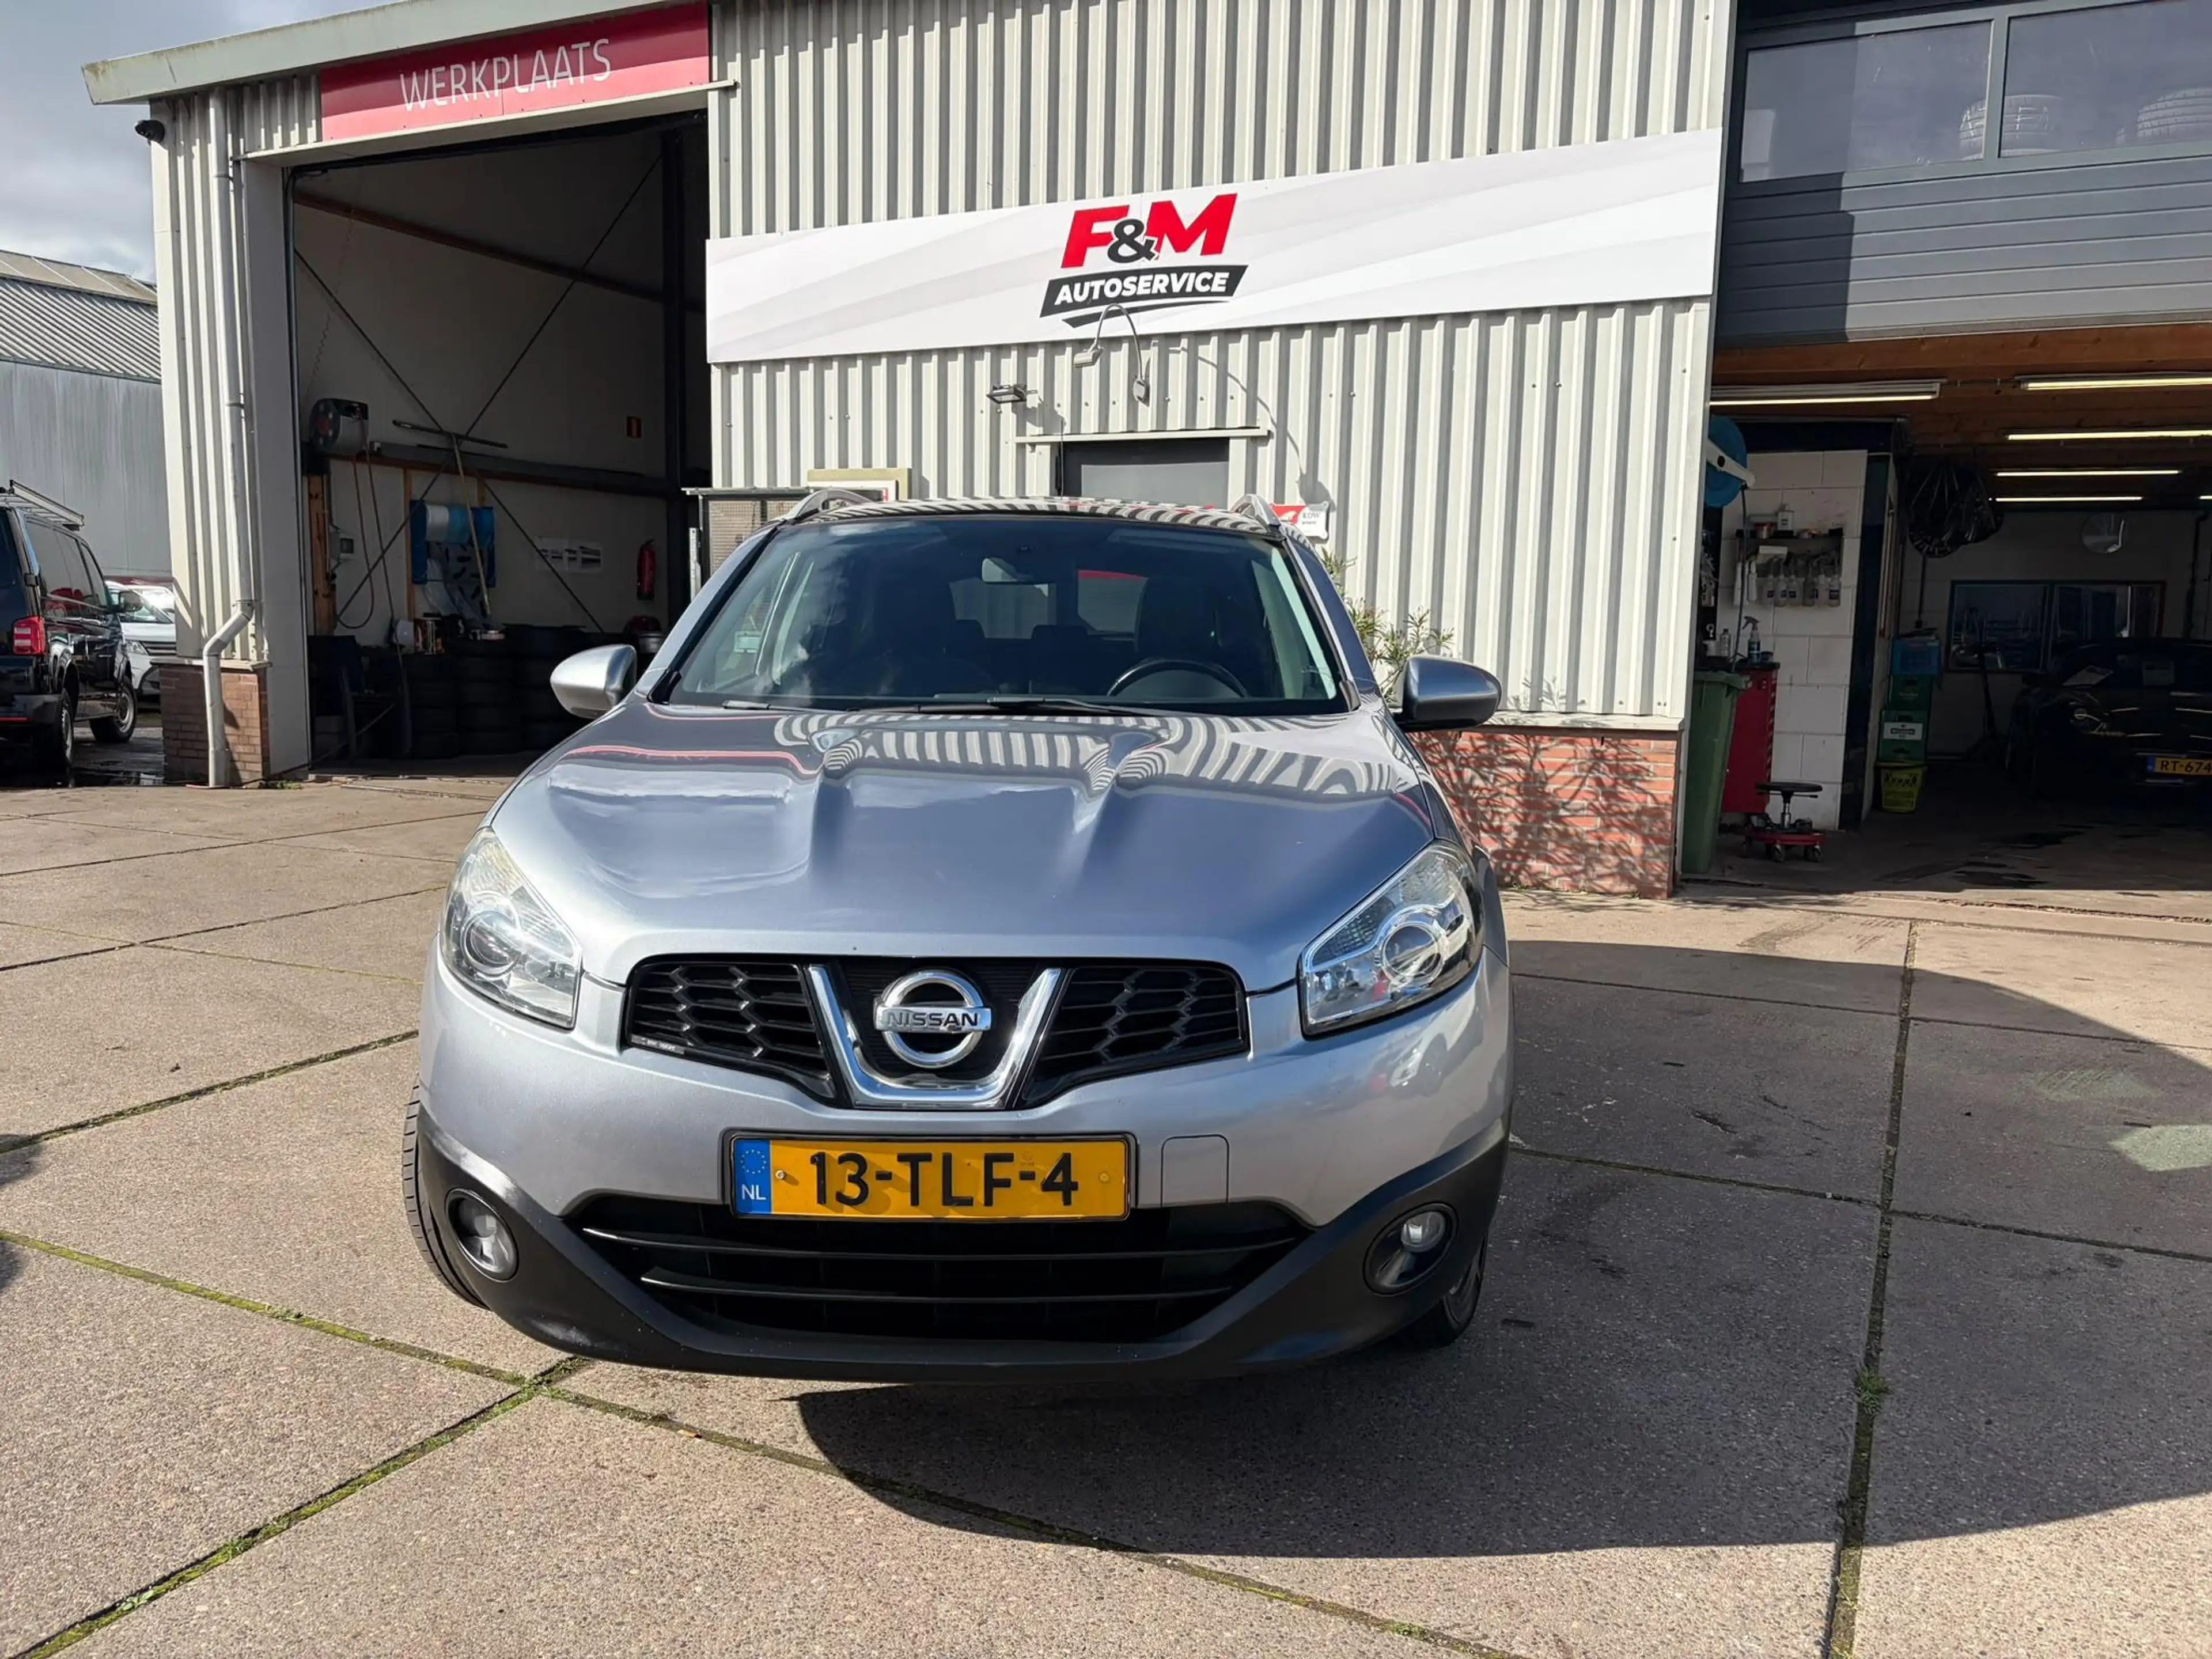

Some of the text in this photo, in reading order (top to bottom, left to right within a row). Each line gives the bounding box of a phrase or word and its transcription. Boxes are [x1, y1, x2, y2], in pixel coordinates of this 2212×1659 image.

[400, 38, 611, 112] WERKPLAATS
[1060, 192, 1238, 268] F&M
[1054, 271, 1230, 306] AUTOSERVICE
[888, 1012, 978, 1027] NISSAN
[741, 1184, 767, 1202] NL
[809, 1152, 1079, 1207] 13-TLF-4
